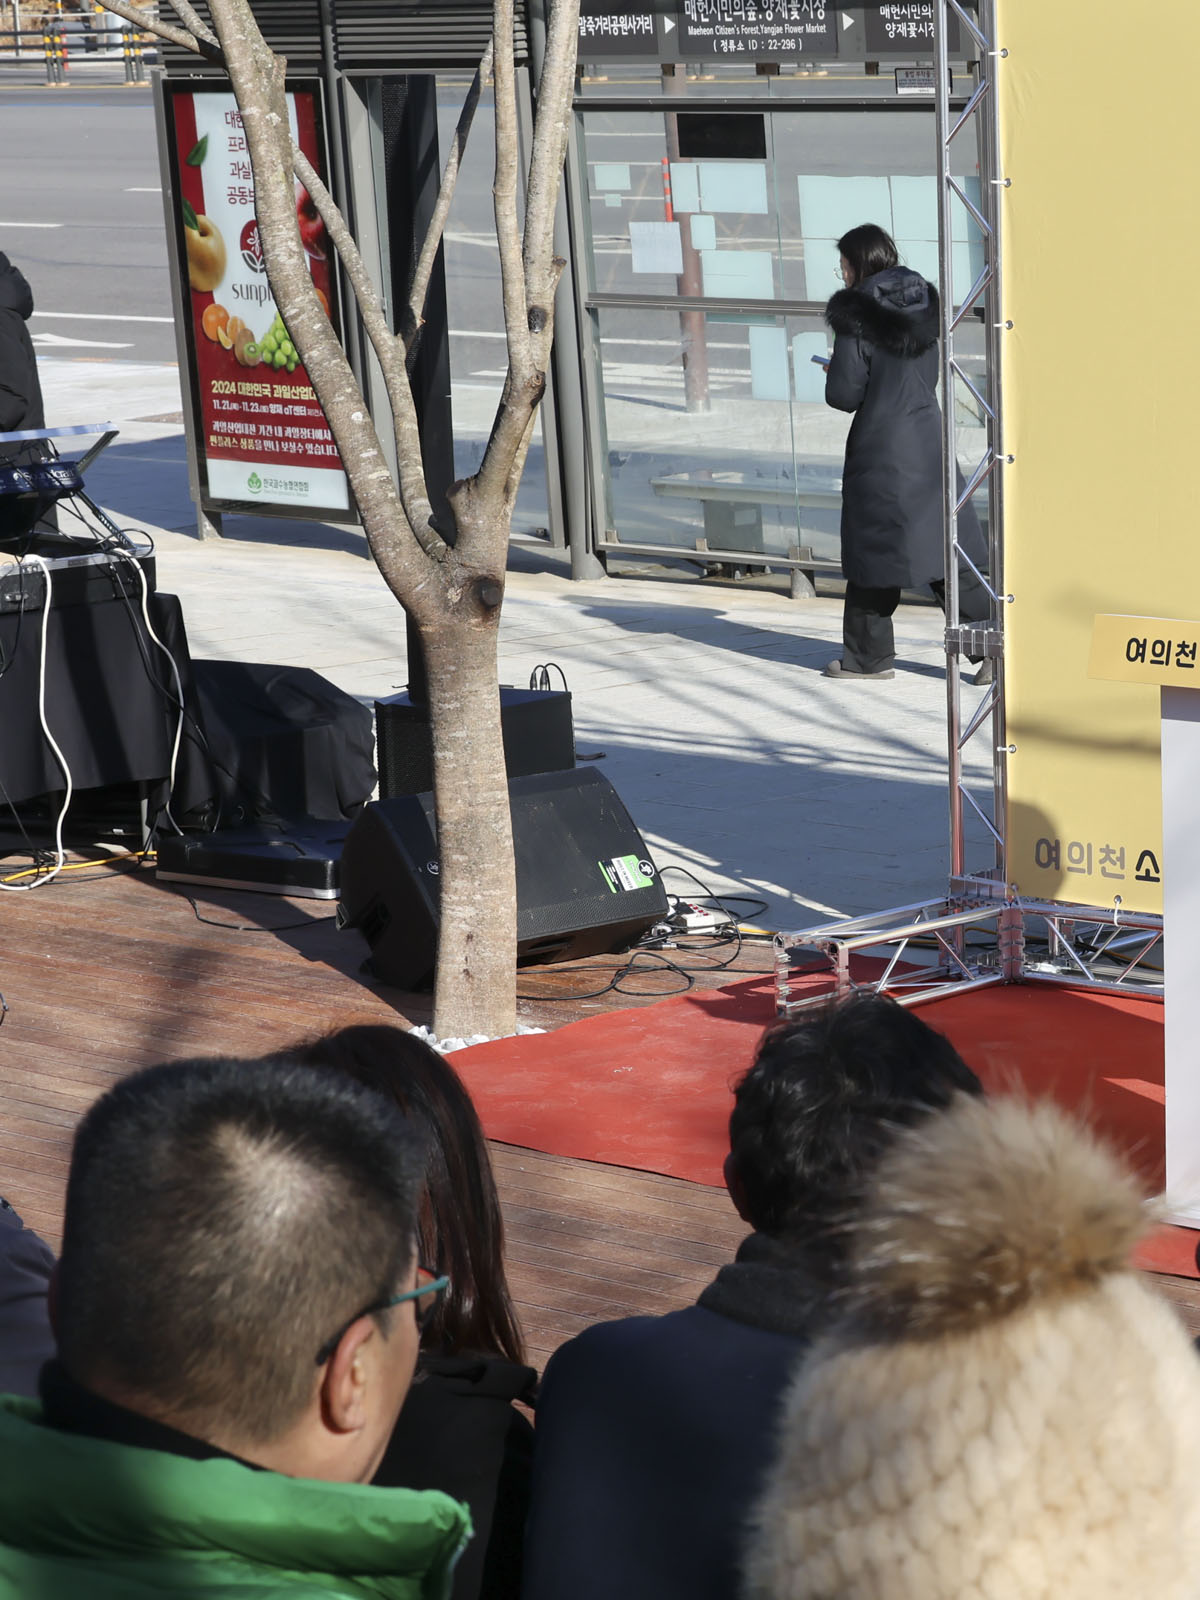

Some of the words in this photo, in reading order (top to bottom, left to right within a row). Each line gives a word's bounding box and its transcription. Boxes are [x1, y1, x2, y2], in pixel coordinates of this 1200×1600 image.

[879, 3, 934, 20] 매헌시민의
[578, 14, 654, 36] 말죽거리공원사거리
[688, 25, 714, 35] Maeheon
[715, 24, 740, 35] Citizen's
[784, 24, 804, 34] Flower
[805, 24, 827, 33] Market
[720, 40, 745, 53] 정류소
[748, 40, 758, 50] ID
[767, 39, 796, 50] 22-296
[211, 380, 236, 394] 2024
[237, 382, 271, 398] 대한민국
[1125, 636, 1198, 670] 여의천
[1034, 837, 1126, 880] 여의천
